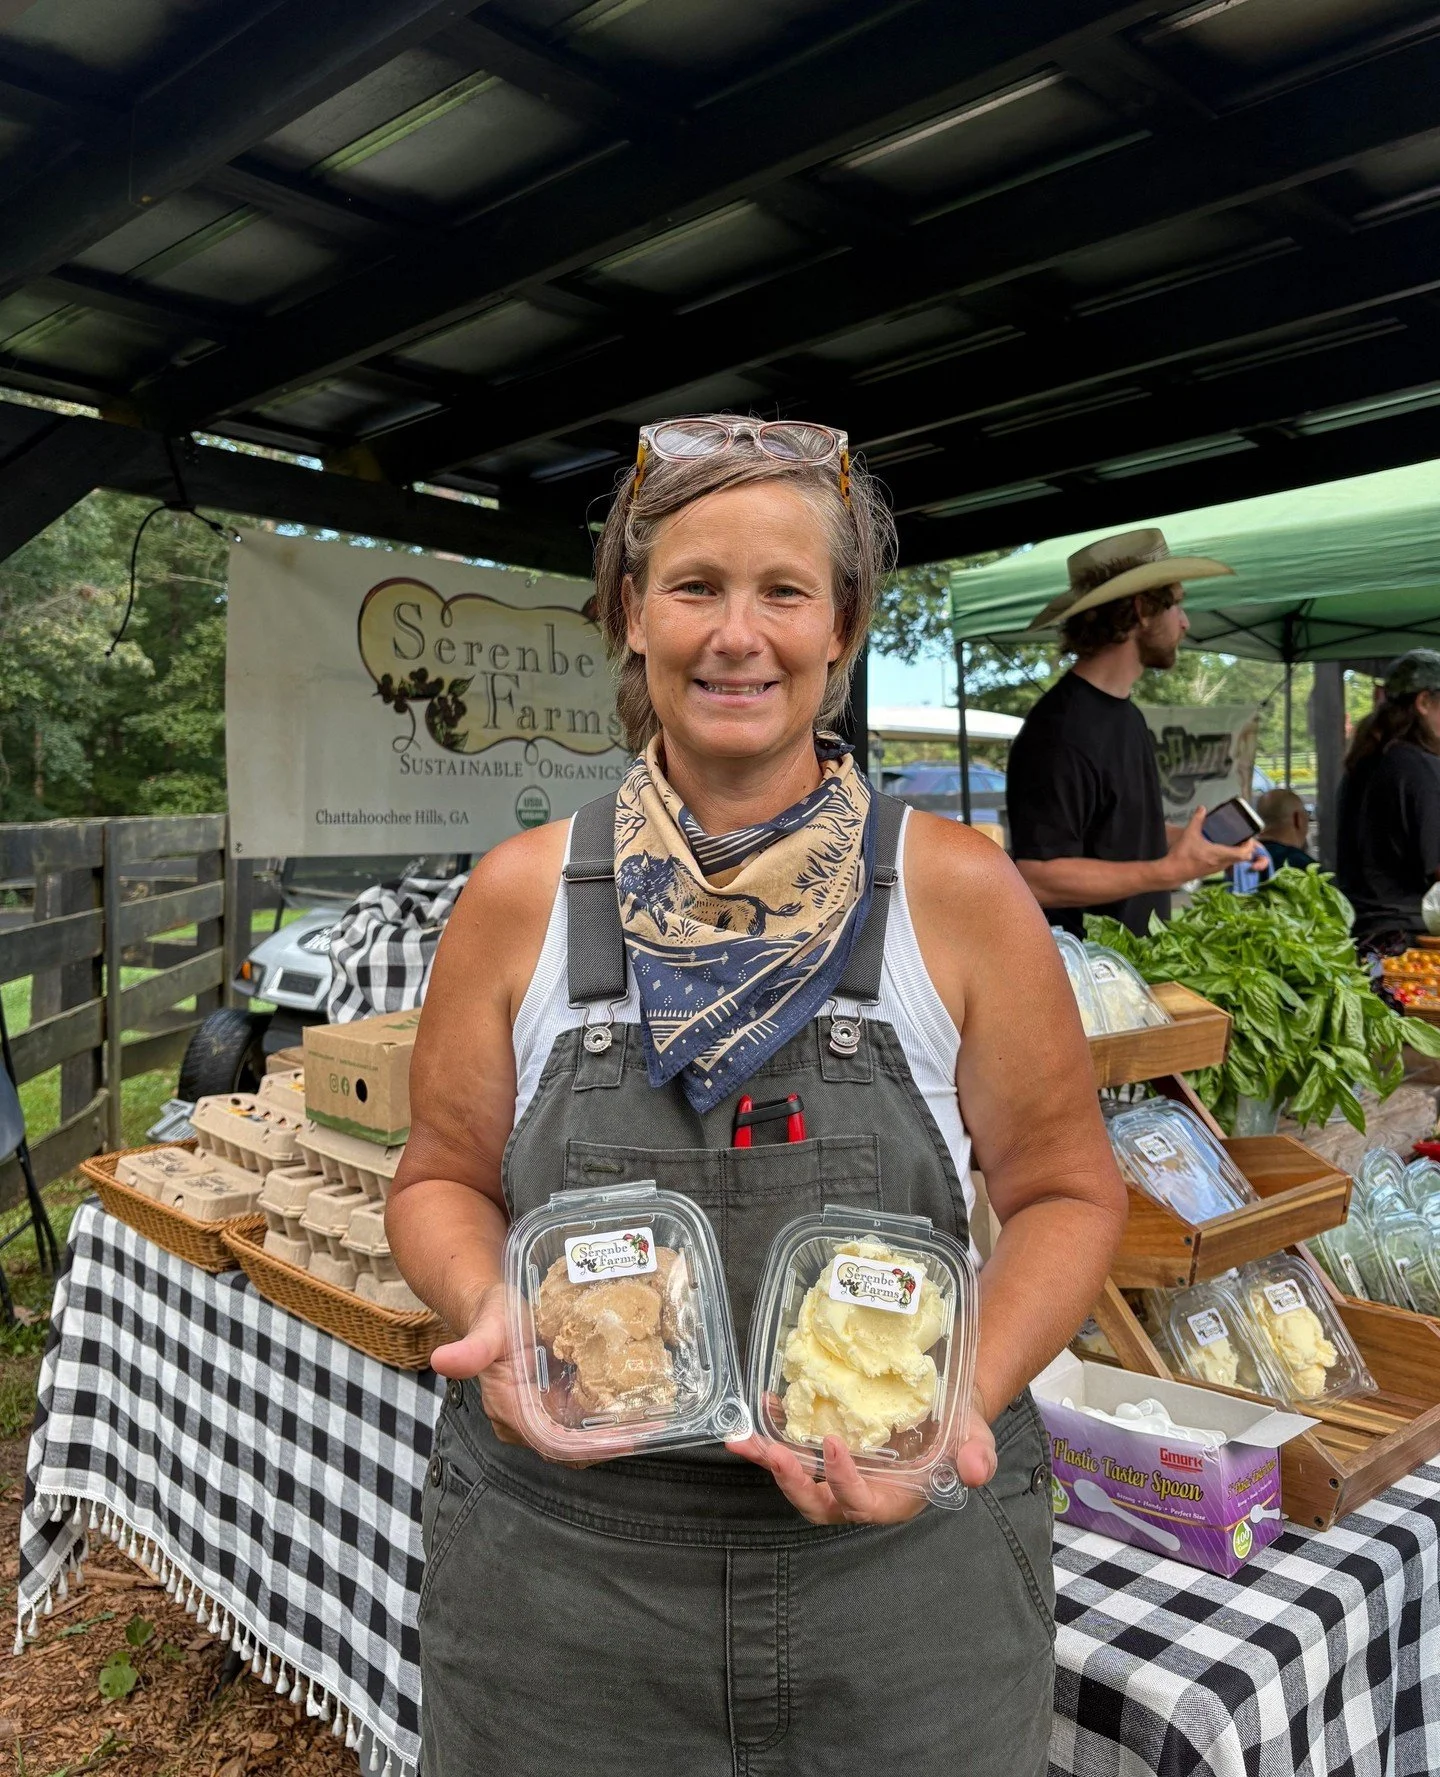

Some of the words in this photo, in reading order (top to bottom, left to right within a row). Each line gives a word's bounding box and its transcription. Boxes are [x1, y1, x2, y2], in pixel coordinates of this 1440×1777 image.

[393, 602, 595, 678] Serenbe
[480, 671, 623, 737] Farms
[400, 753, 523, 778] SUSTAINABLE
[538, 758, 622, 780] ORGANICS
[315, 808, 412, 825] Chattahoochee
[415, 808, 446, 826] Hills,
[449, 811, 469, 825] GA
[579, 1243, 628, 1259] Serenbe
[597, 1254, 637, 1267] Farms
[845, 1267, 894, 1286] Serenbe
[862, 1281, 900, 1299] Farms
[1159, 1447, 1203, 1468] Gmark
[1053, 1438, 1100, 1473] Plastic
[1101, 1456, 1149, 1488] Taster
[1151, 1469, 1203, 1502] Spoon
[1116, 1492, 1136, 1504] Strong
[1170, 1507, 1192, 1518] Perfect
[1193, 1512, 1206, 1521] Size
